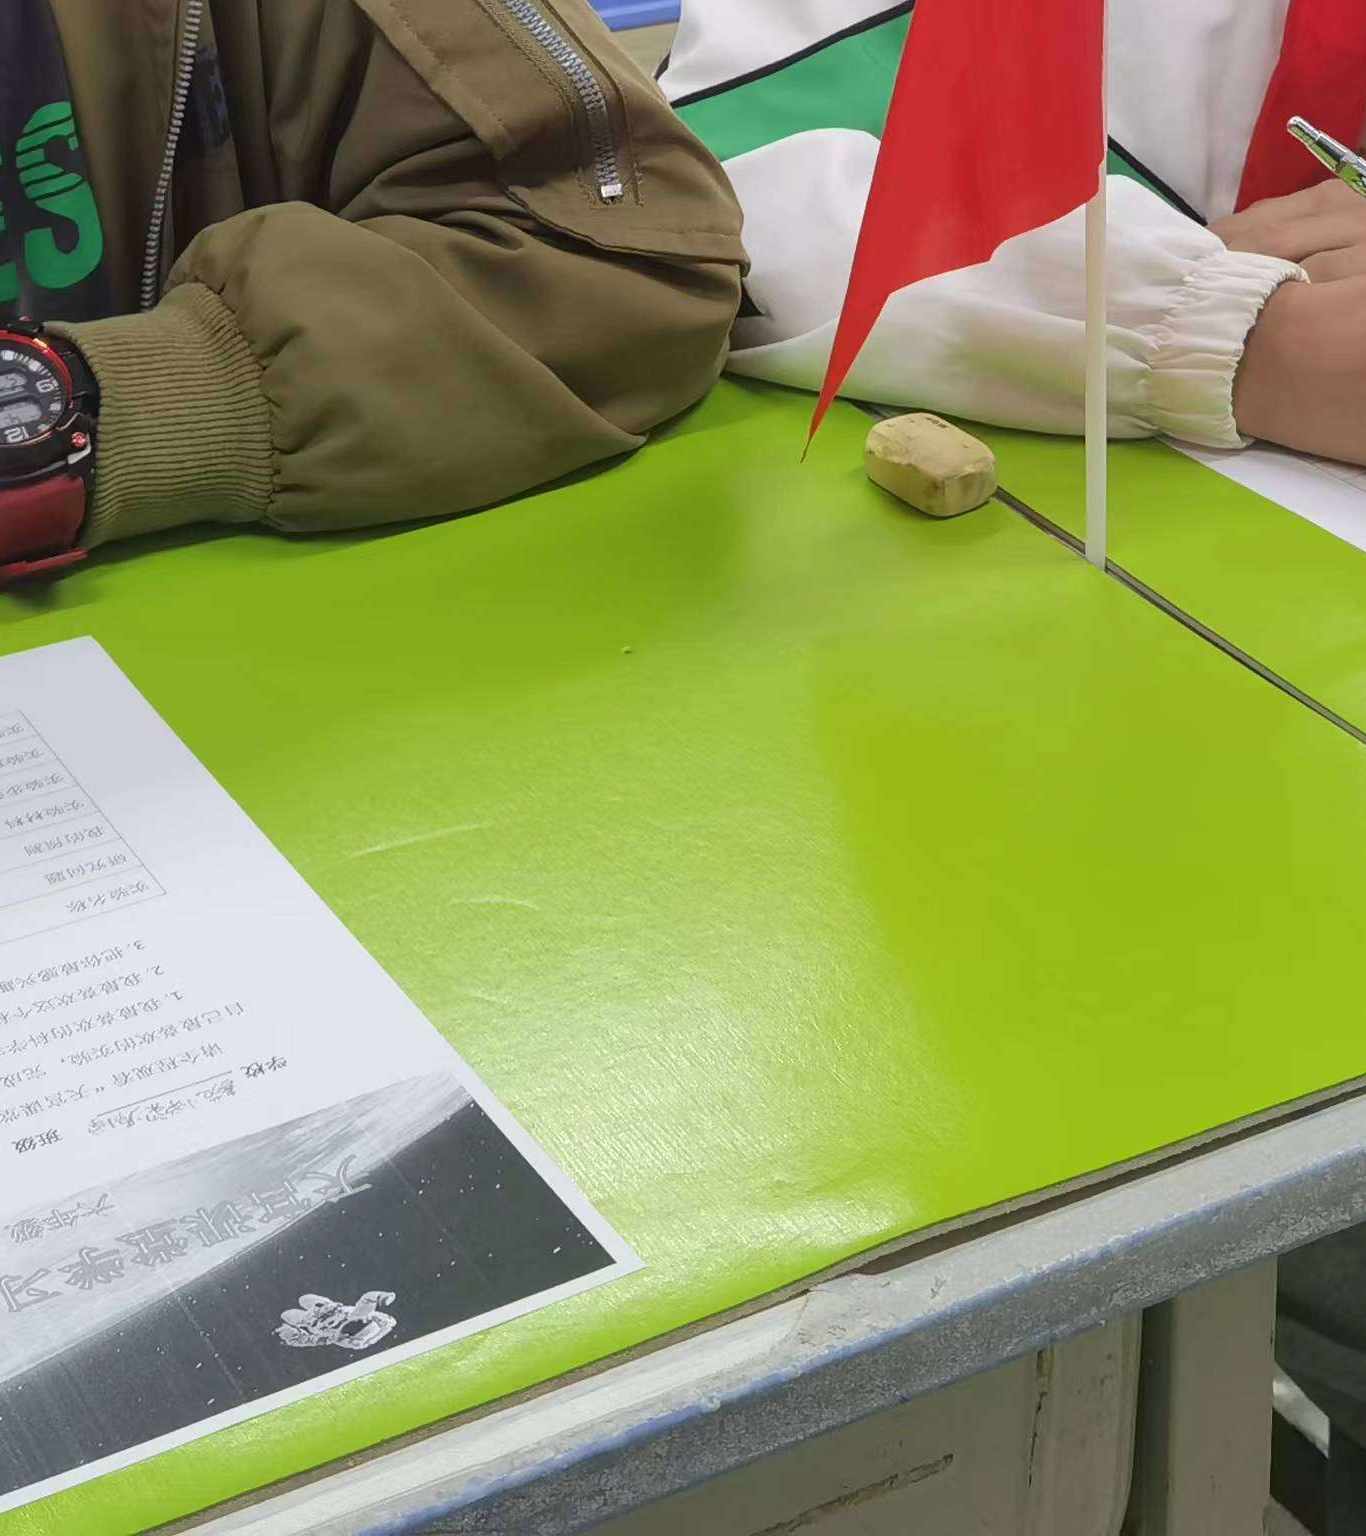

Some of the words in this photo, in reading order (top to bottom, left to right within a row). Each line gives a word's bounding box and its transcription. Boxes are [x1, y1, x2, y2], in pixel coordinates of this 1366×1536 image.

[0, 798, 87, 829] 实验材料
[20, 825, 107, 856] 我的预测
[41, 852, 129, 885] 研究问题
[61, 879, 151, 914] 实验名称
[239, 1053, 290, 1079] 学校
[9, 1127, 64, 1155] 班级
[2, 1191, 121, 1250] 六年级
